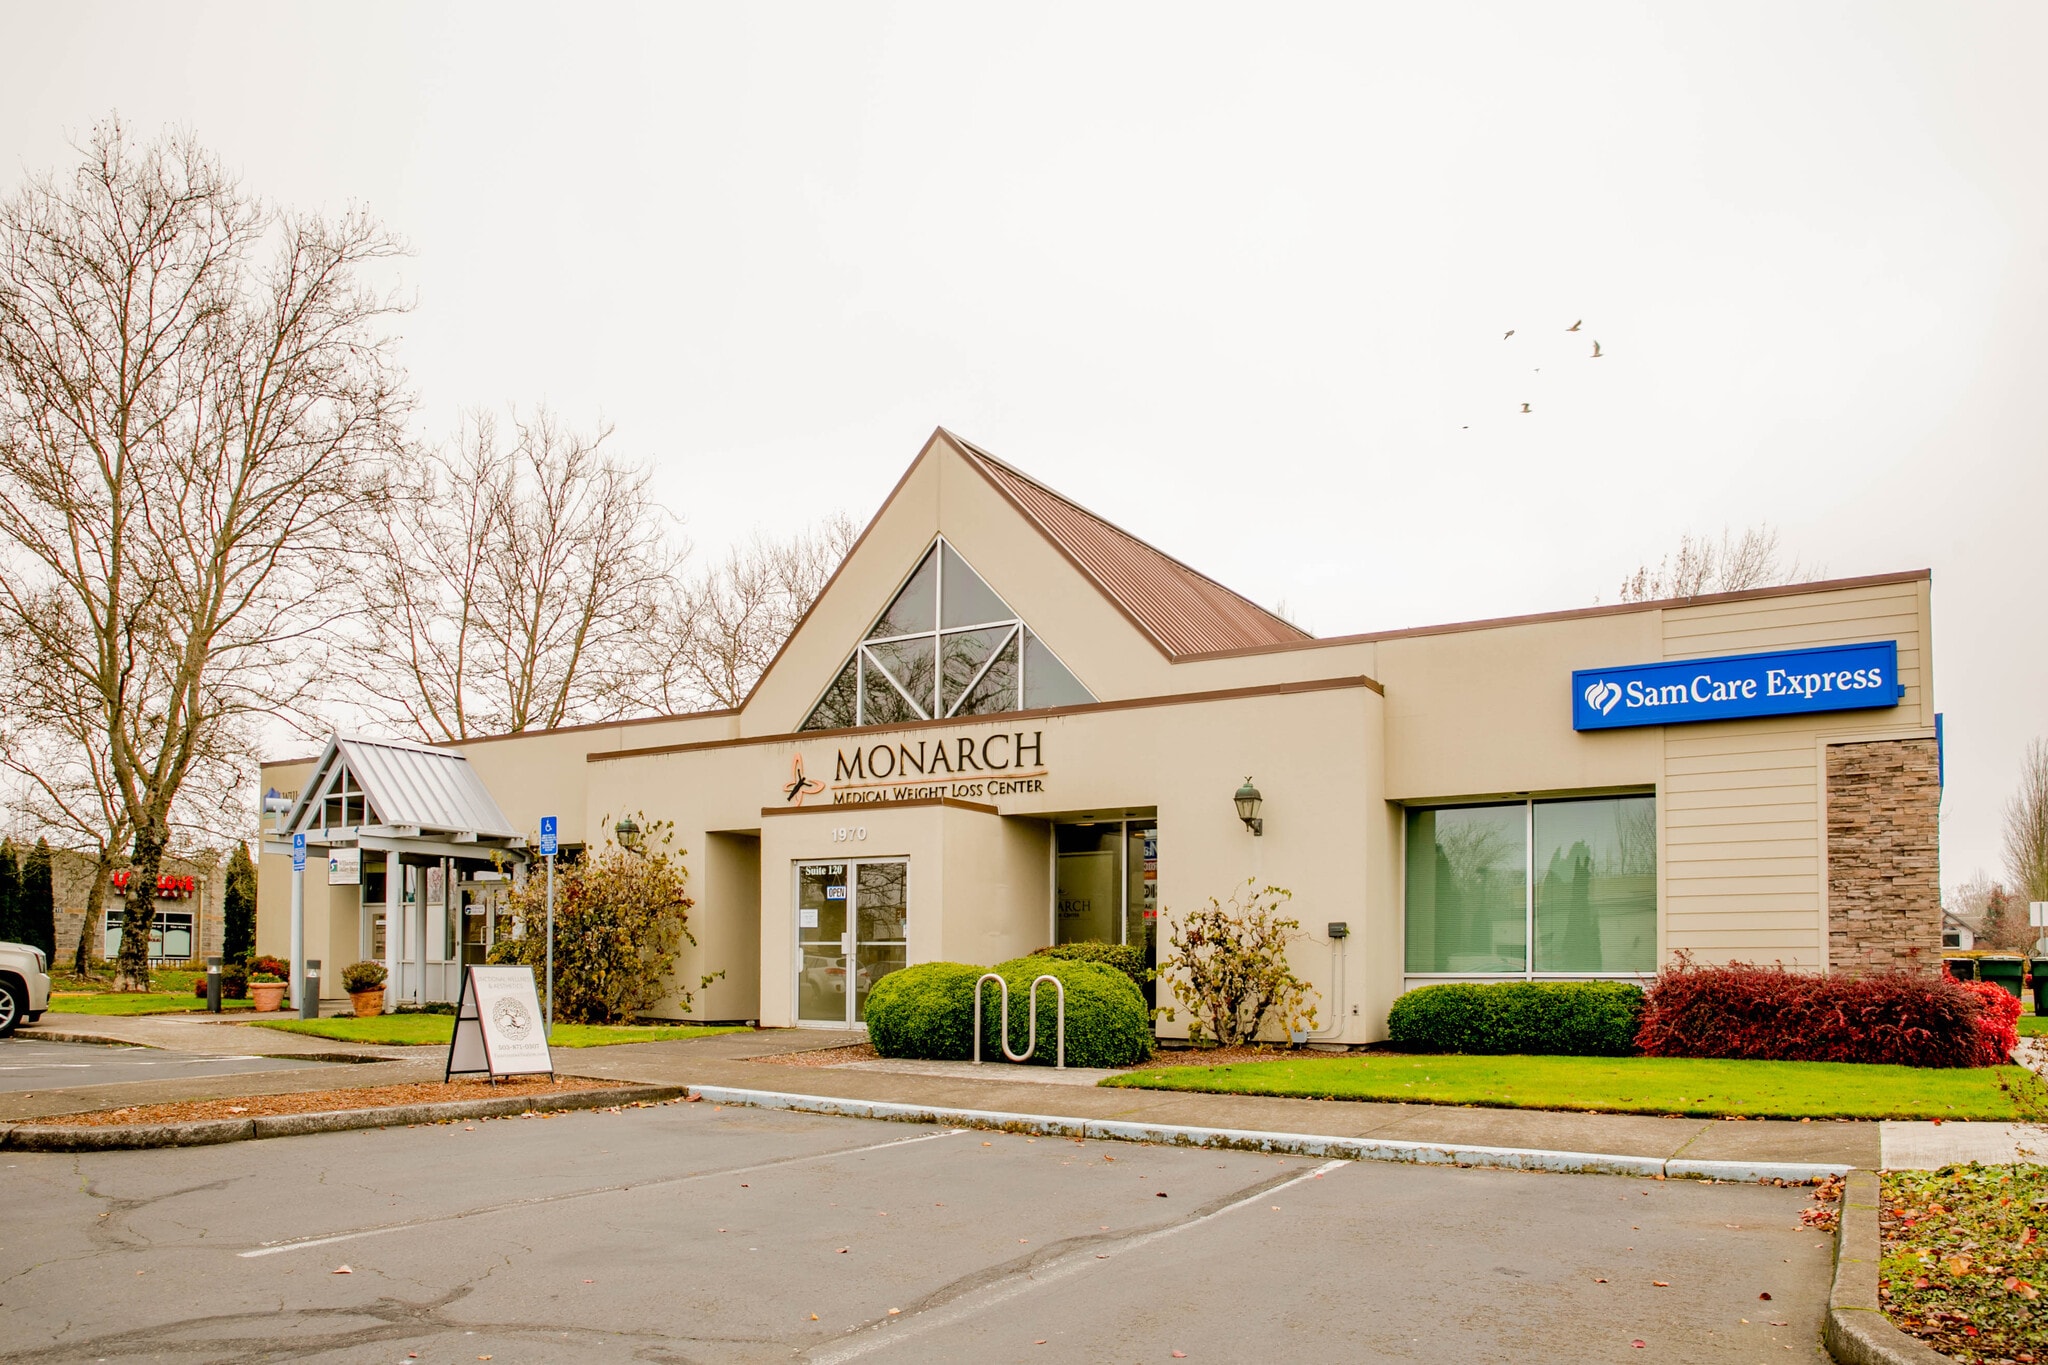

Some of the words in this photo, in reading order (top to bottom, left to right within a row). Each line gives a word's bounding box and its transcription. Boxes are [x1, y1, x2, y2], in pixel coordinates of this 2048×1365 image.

[1625, 674, 1757, 708] SamCare
[1766, 667, 1882, 700] Express
[834, 731, 1045, 781] MONARCH
[833, 791, 889, 805] MEDICAL
[893, 786, 947, 800] WEIGHT
[952, 783, 983, 798] LOSS
[987, 779, 1045, 796] CENTER
[831, 826, 867, 843] 1970
[805, 865, 827, 876] Suite
[828, 864, 843, 875] 120
[828, 887, 845, 898] OPEN
